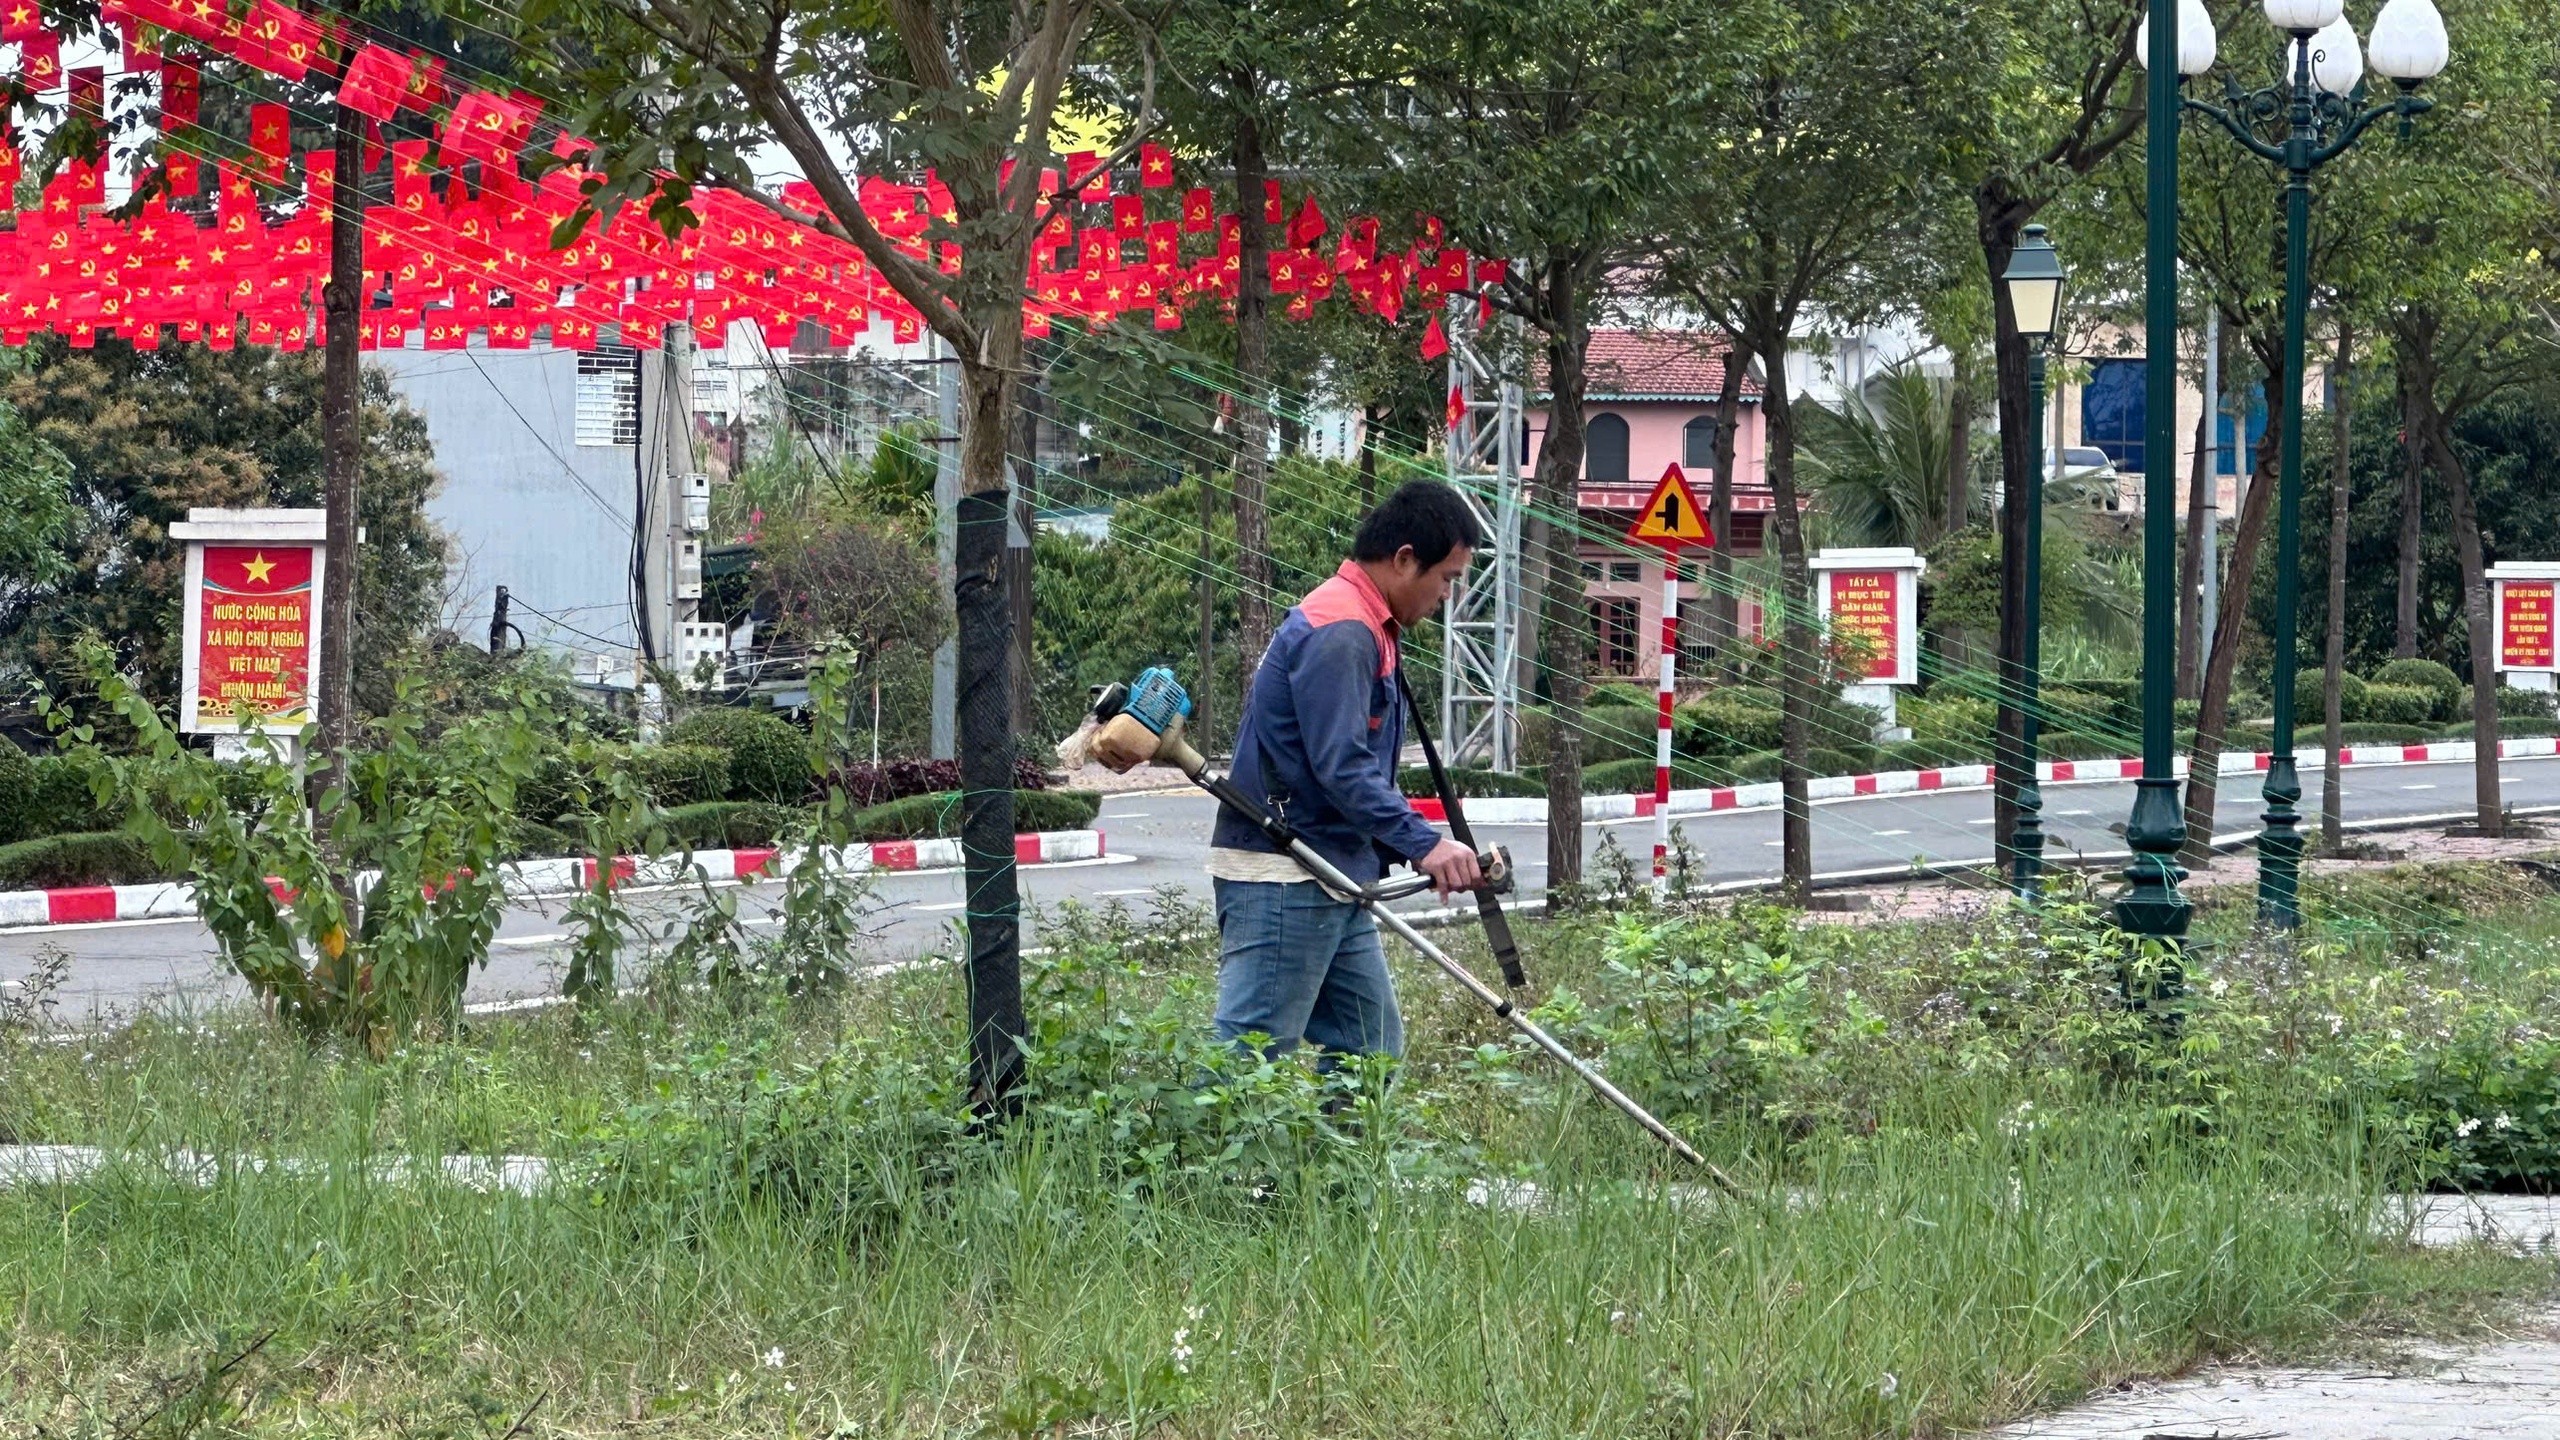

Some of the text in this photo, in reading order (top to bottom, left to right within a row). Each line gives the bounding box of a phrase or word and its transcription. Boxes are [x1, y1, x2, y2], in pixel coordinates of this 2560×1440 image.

[213, 602, 301, 624] NƯỚC CỘNG HÒA
[207, 626, 305, 649] XÃ HỘI CHỦ NGHĨA
[229, 654, 281, 675] VIỆT NAM
[221, 679, 286, 699] MUÔN NĂM!
